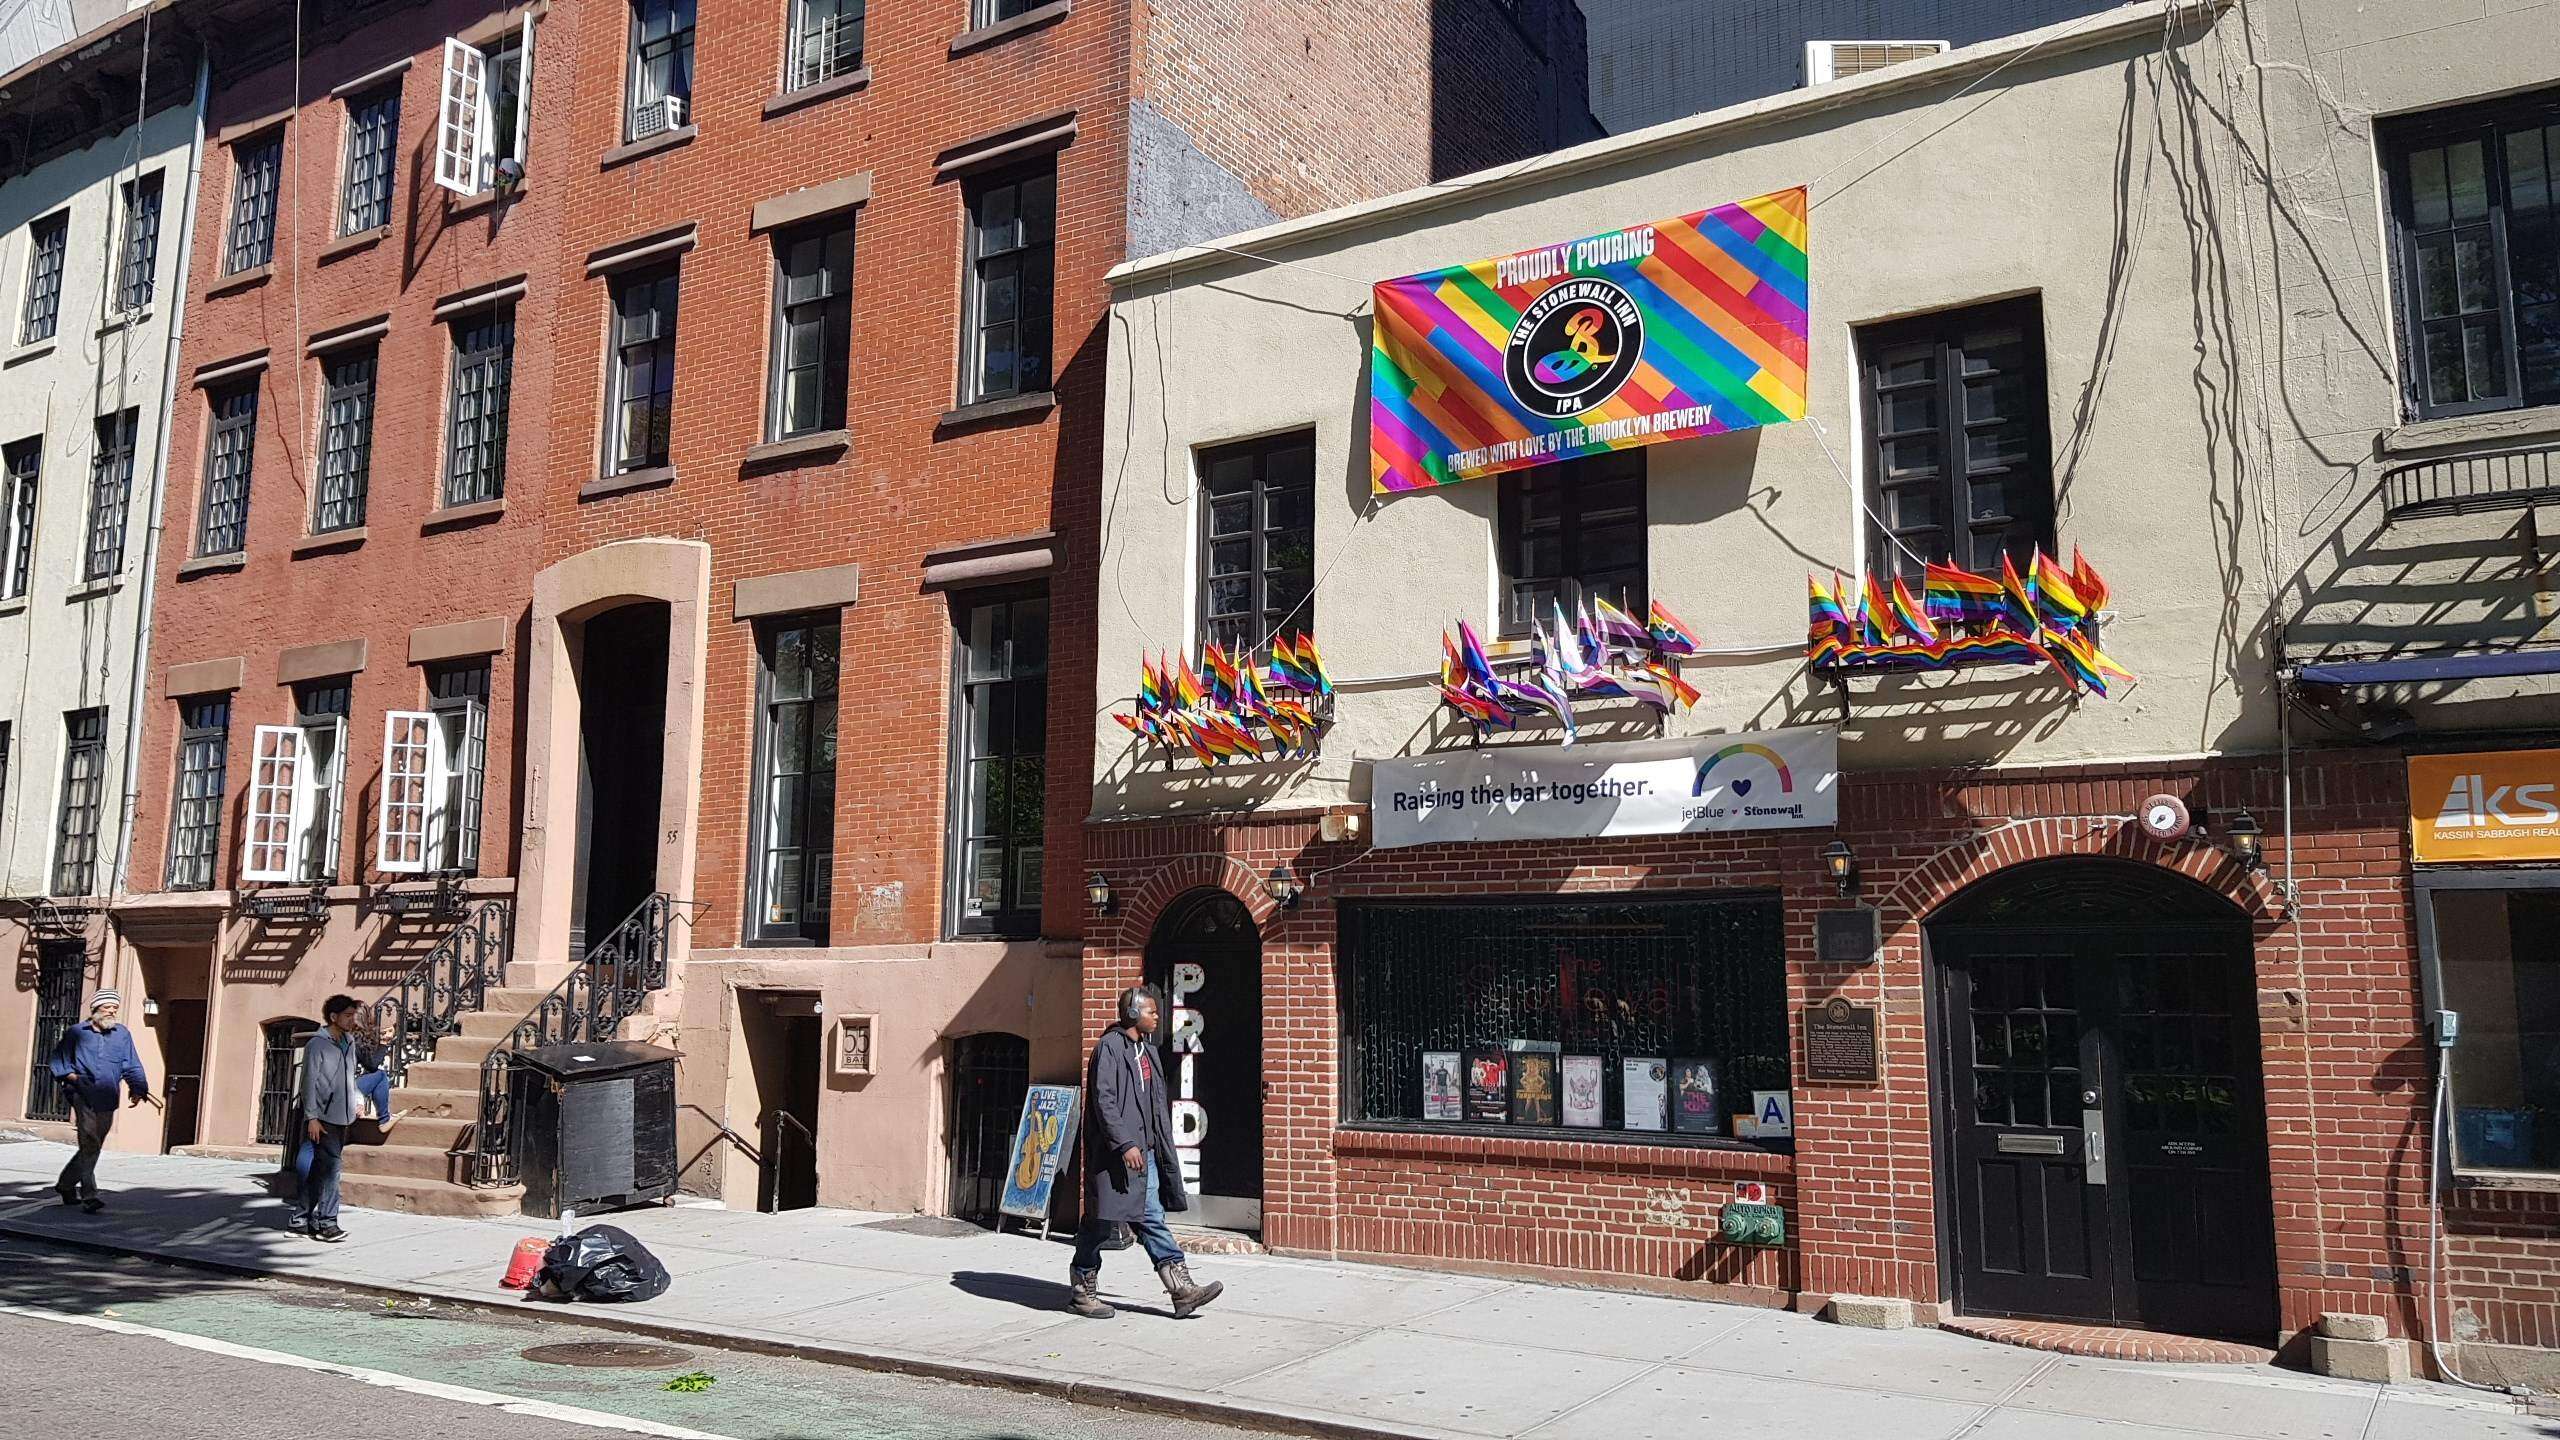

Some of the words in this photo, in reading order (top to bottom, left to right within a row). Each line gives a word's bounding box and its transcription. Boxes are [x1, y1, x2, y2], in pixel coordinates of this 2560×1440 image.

[1496, 244, 1573, 289] PROUDLY
[1576, 226, 1655, 270] POURING
[1511, 318, 1534, 348] THE
[1532, 282, 1618, 320] STONEWALL
[1614, 301, 1637, 328] INN
[1556, 397, 1582, 413] IPA
[1447, 449, 1488, 474] BREWED
[1488, 442, 1518, 466] WITH
[1519, 437, 1546, 460] LOVE
[1547, 432, 1562, 454] BY
[1563, 429, 1586, 450] THE
[1588, 419, 1651, 446] BROOKLYN
[1652, 405, 1712, 433] BREWERY
[1393, 783, 1465, 812] Raising
[1471, 782, 1504, 804] the
[1510, 782, 1542, 804] bar
[1552, 778, 1654, 802] together.
[1681, 805, 1724, 823] jetBlue
[1744, 804, 1802, 818] Stonewall
[666, 830, 678, 844] 55
[2434, 831, 2473, 840] KASSIN
[2477, 830, 2530, 839] SABBAGH
[845, 1026, 869, 1053] 55
[1172, 963, 1208, 1195] PRIDE
[1038, 1101, 1057, 1110] JAZZ
[1040, 1090, 1057, 1100] LIVE
[1762, 1096, 1785, 1123] A
